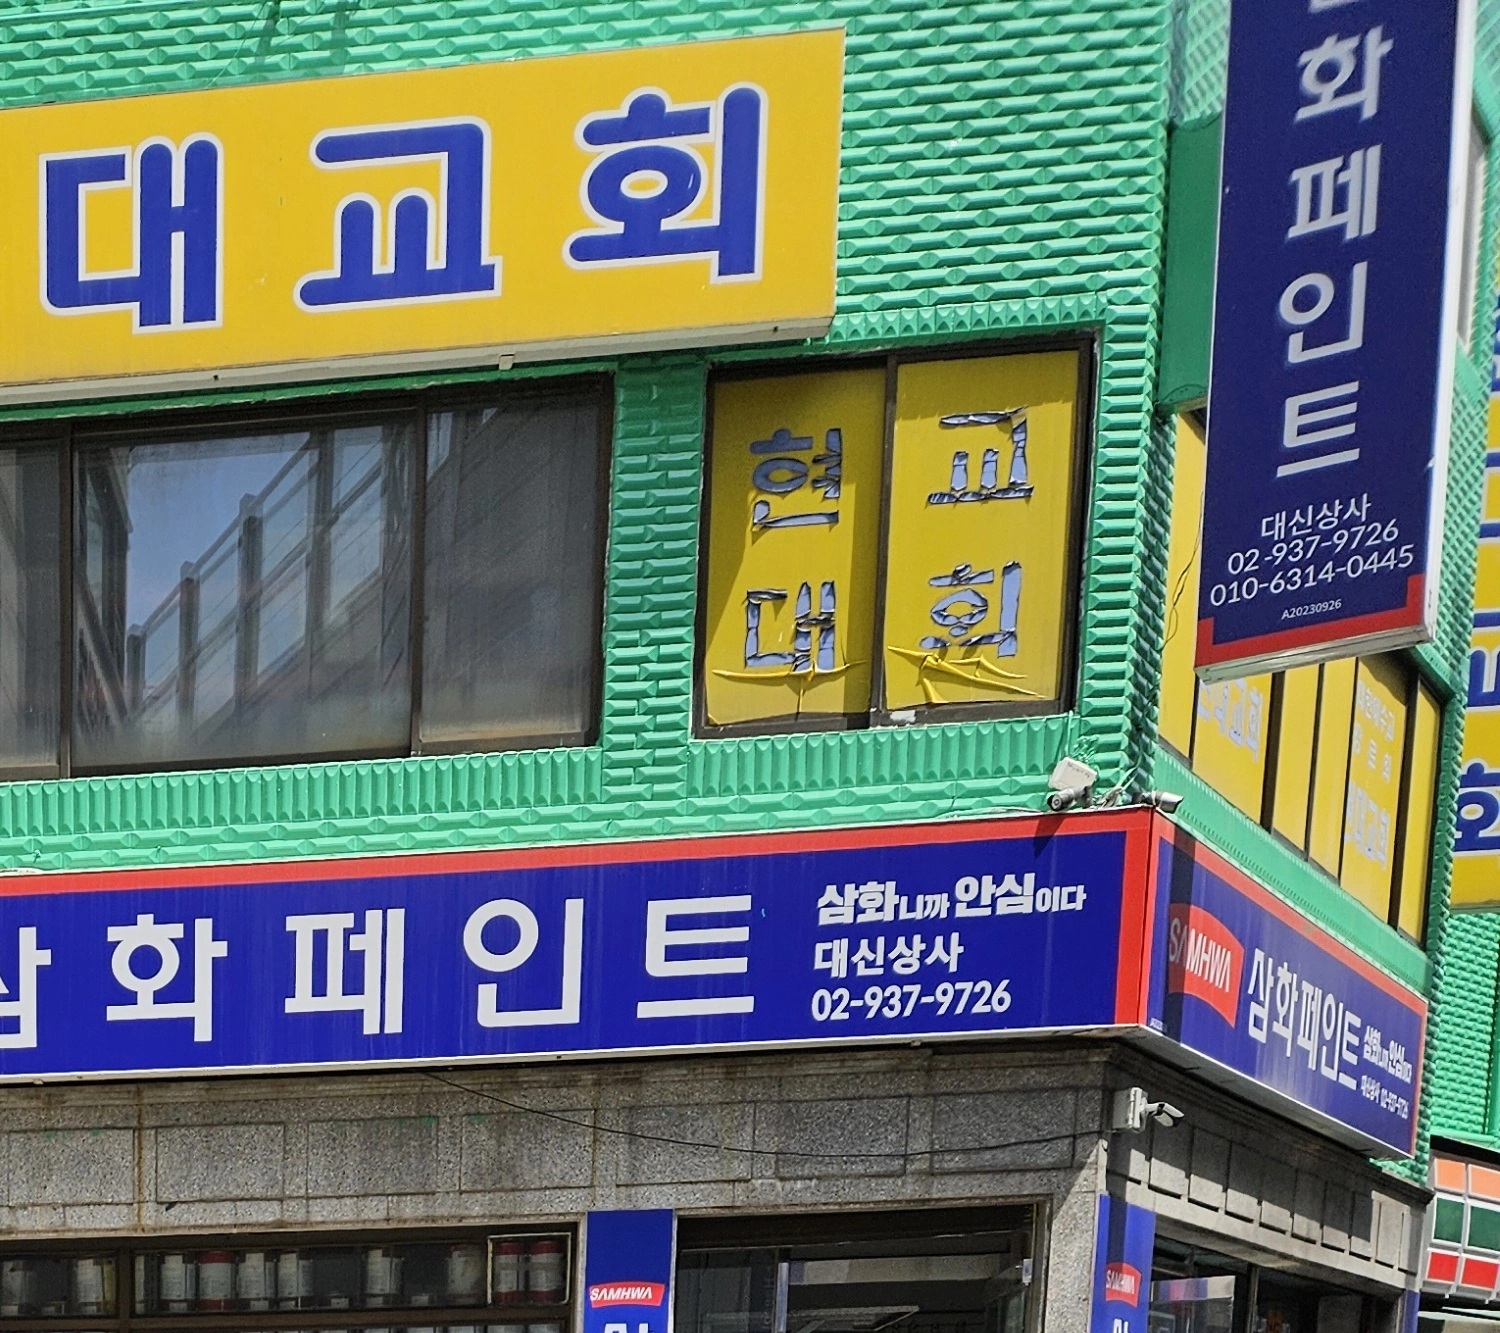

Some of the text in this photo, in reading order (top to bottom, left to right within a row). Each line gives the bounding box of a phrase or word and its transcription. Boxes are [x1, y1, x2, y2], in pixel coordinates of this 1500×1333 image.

[1275, 0, 1393, 480] 화페인트
[1261, 493, 1372, 540] 대신상사
[1210, 544, 1415, 608] 010-6314-0445
[1281, 599, 1342, 621] A20230926
[816, 871, 1087, 927] 삼화니까 안심이다
[814, 933, 965, 979] 대신상사
[811, 979, 1012, 1023] 02-937-9726
[1247, 948, 1362, 1091] 삼화페인트
[589, 1285, 653, 1301] SAMHWA
